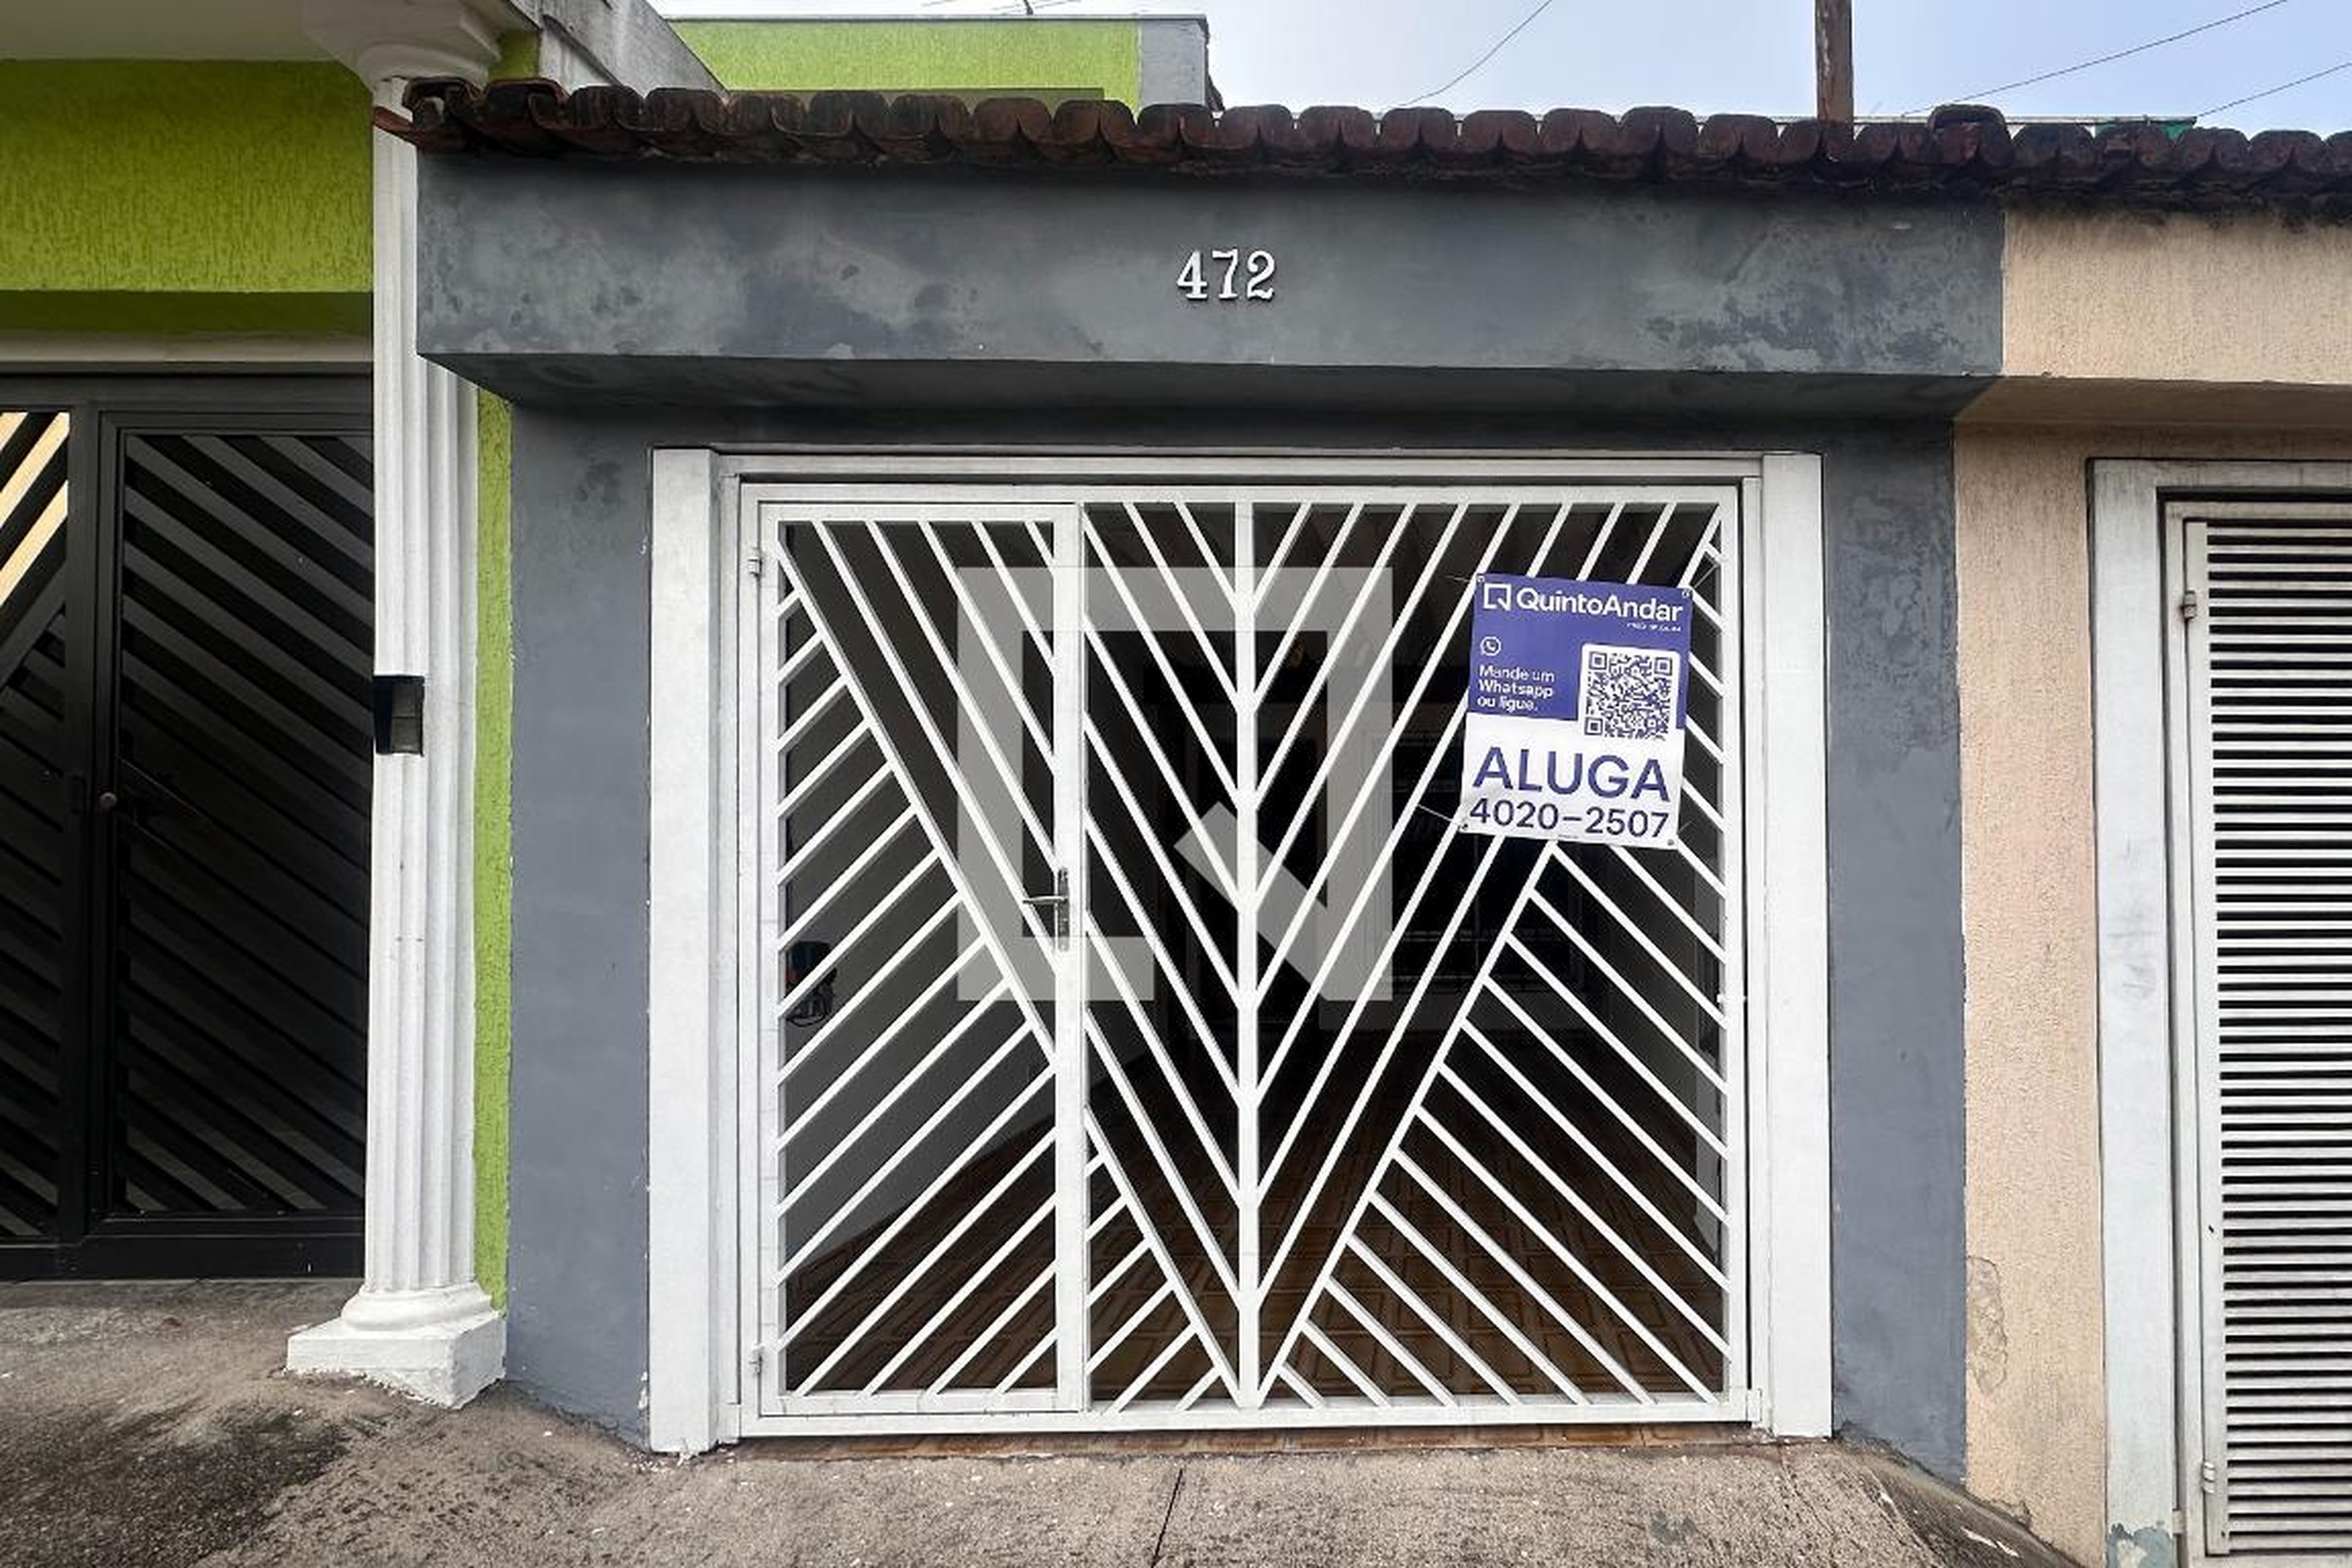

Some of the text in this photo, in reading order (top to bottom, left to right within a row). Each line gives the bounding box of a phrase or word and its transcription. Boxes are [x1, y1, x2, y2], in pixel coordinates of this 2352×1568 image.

[1177, 248, 1275, 300] 472
[1516, 587, 1683, 622] QuintoAndar
[1478, 679, 1553, 699] Whatsapp
[1479, 665, 1555, 683] Mande um
[1477, 696, 1496, 707] ou
[1472, 746, 1671, 802] ALUGA
[1470, 797, 1669, 838] 4020-2507
